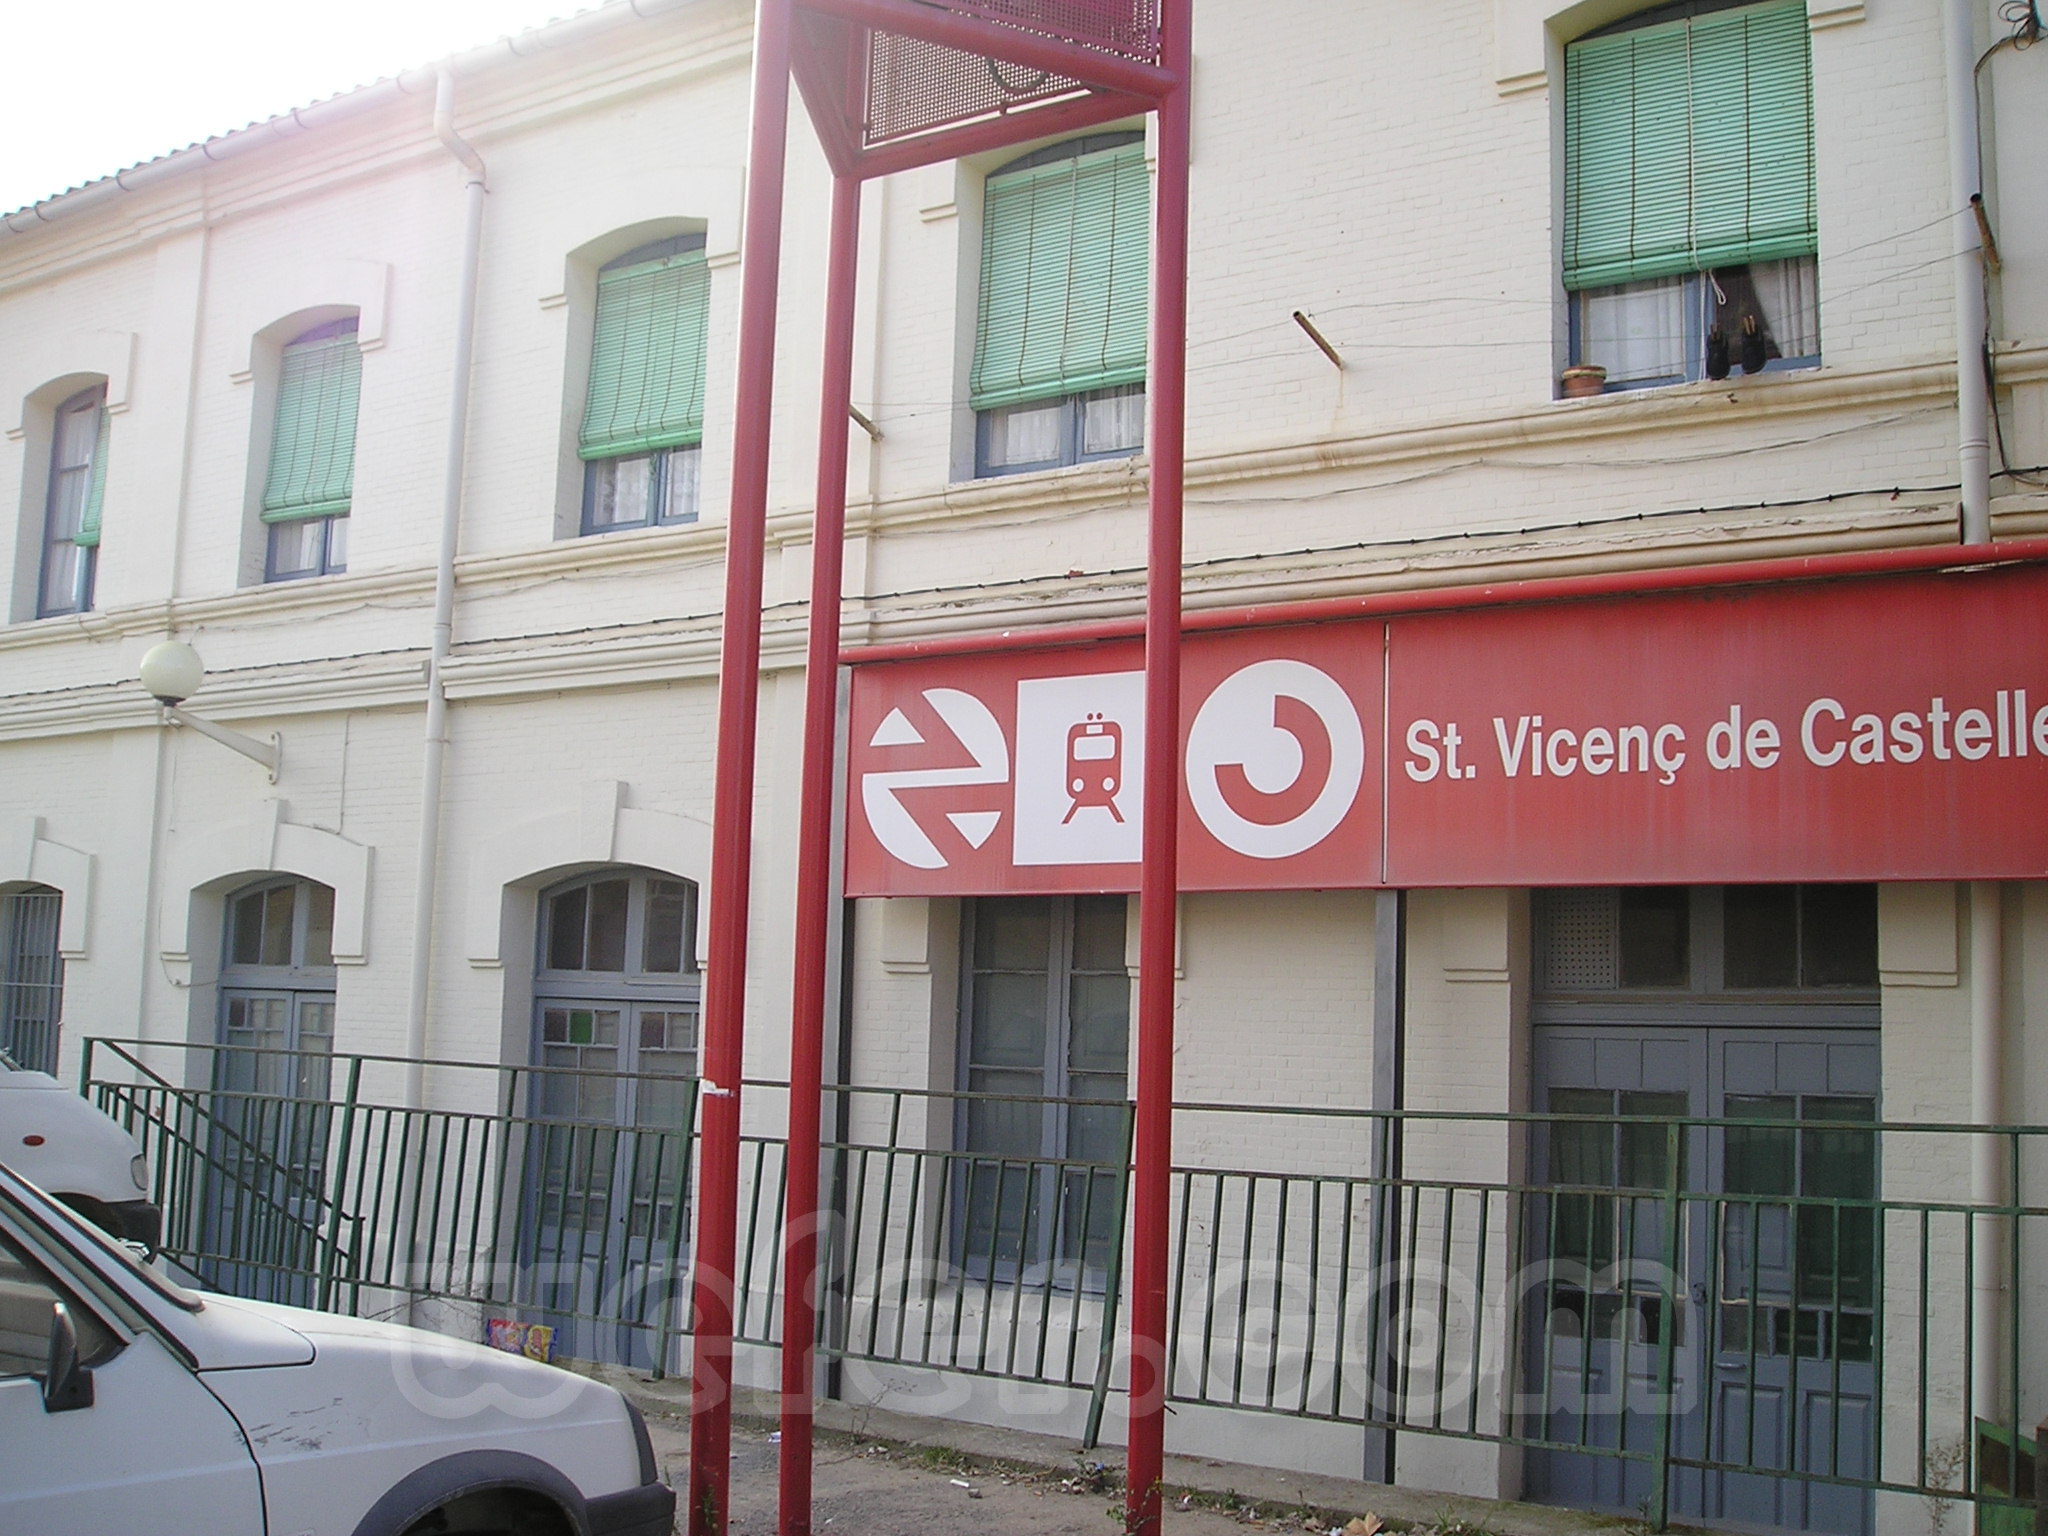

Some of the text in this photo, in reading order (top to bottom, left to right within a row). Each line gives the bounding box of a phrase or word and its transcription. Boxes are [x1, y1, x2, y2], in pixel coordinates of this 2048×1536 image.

[1403, 718, 1477, 783] St.
[1492, 714, 1687, 786] Vicenç
[1705, 704, 1782, 771] de
